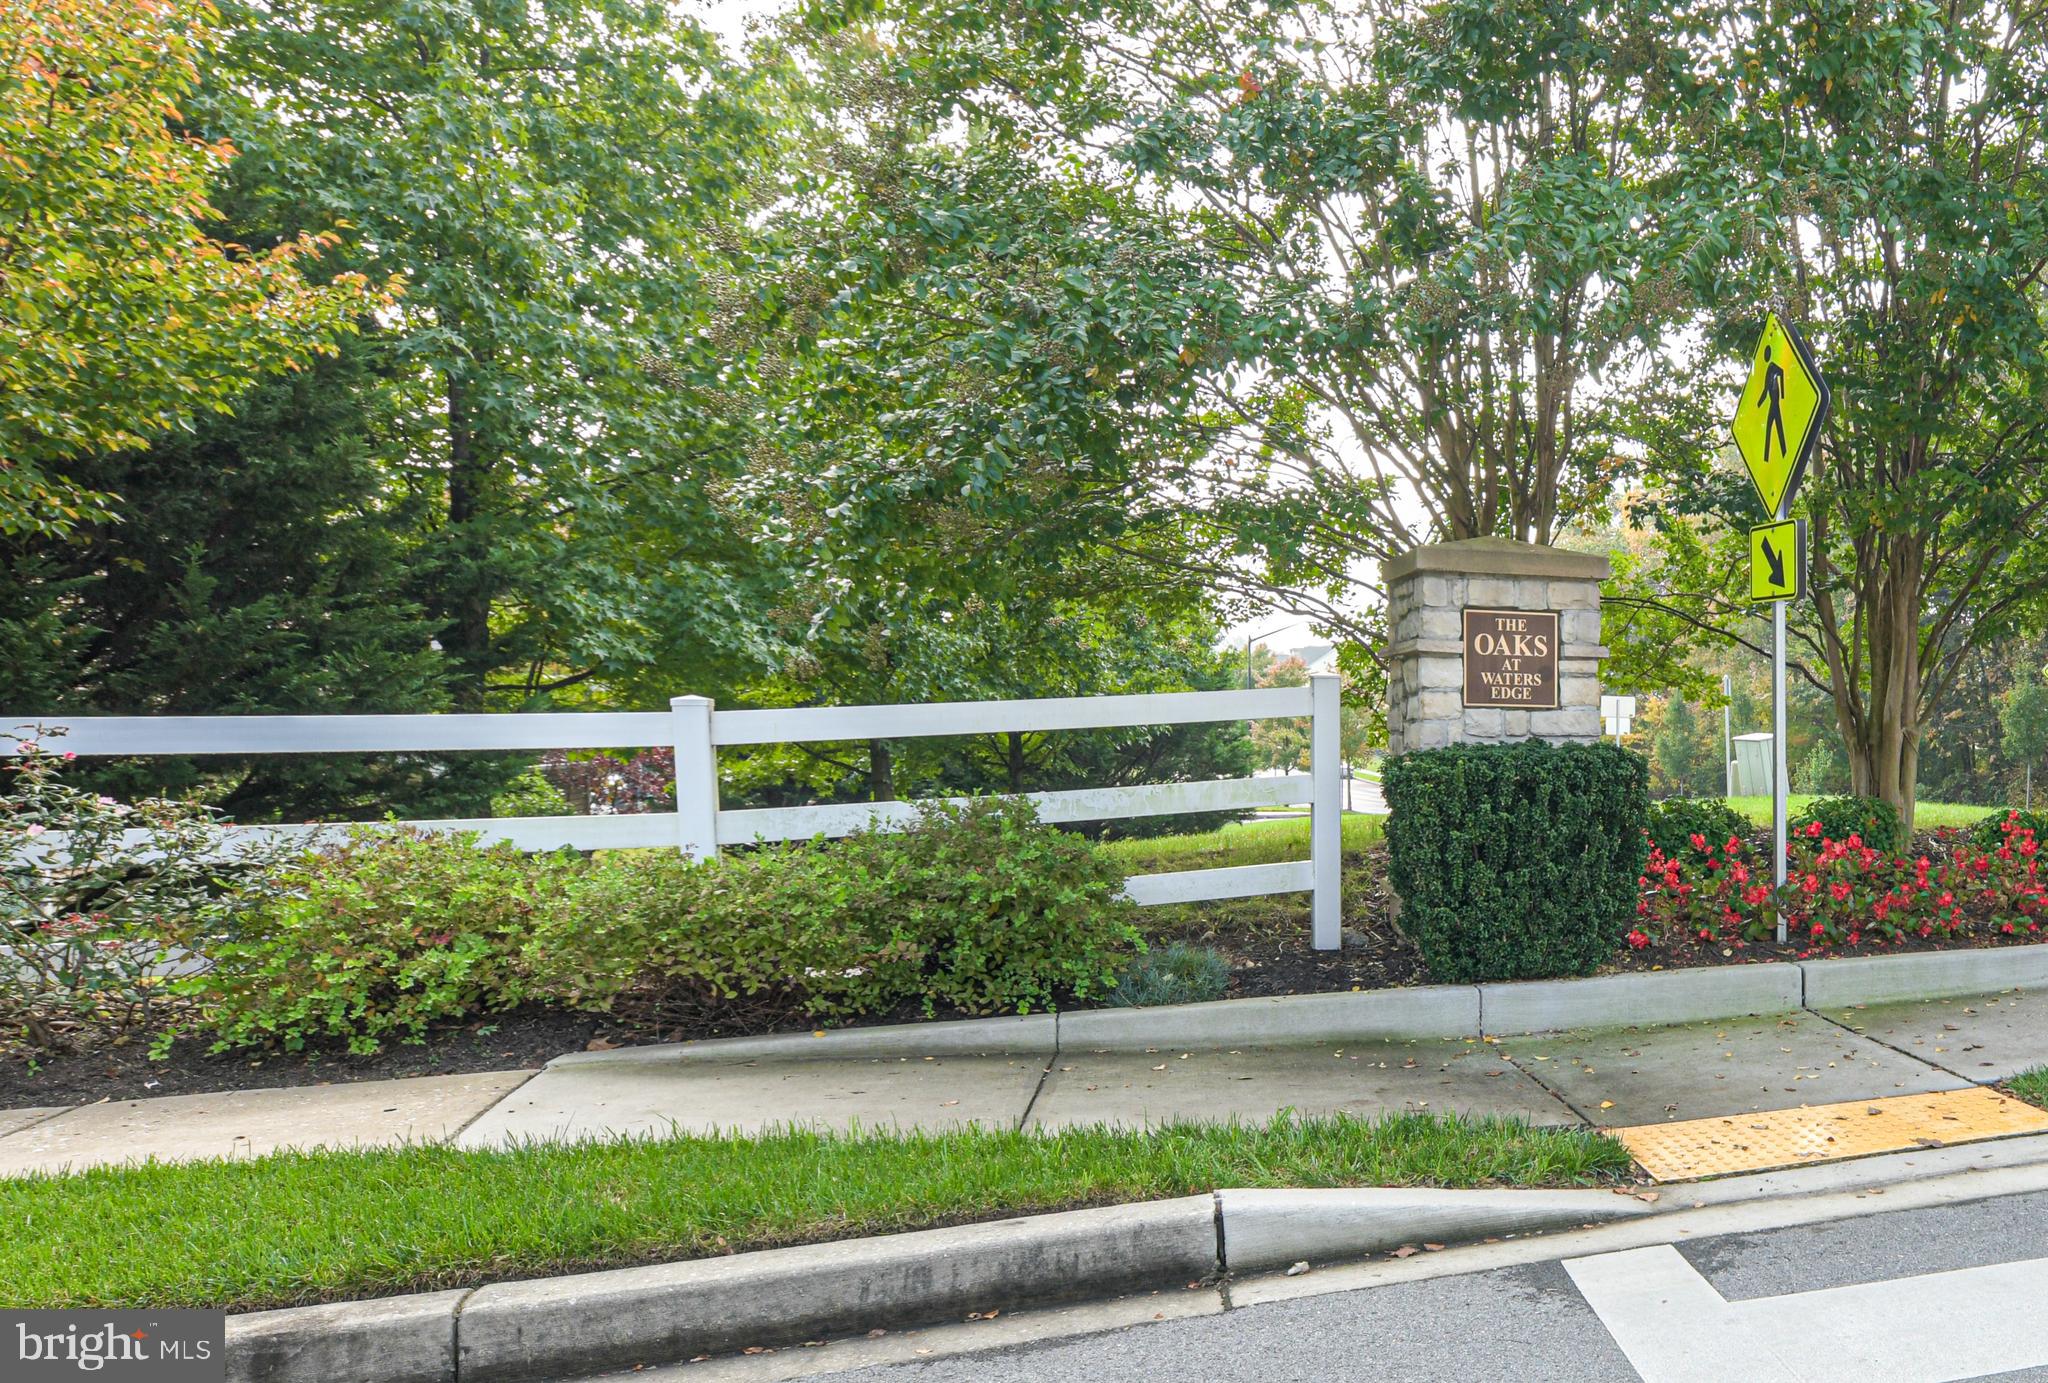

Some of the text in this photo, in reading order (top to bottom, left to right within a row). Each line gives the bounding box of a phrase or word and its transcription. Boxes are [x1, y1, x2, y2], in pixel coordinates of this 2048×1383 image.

[1495, 618, 1527, 632] THE
[1474, 633, 1548, 657] OAKS
[1502, 658, 1522, 671] AT
[1481, 672, 1542, 687] WATERS
[1491, 687, 1532, 700] EDGE
